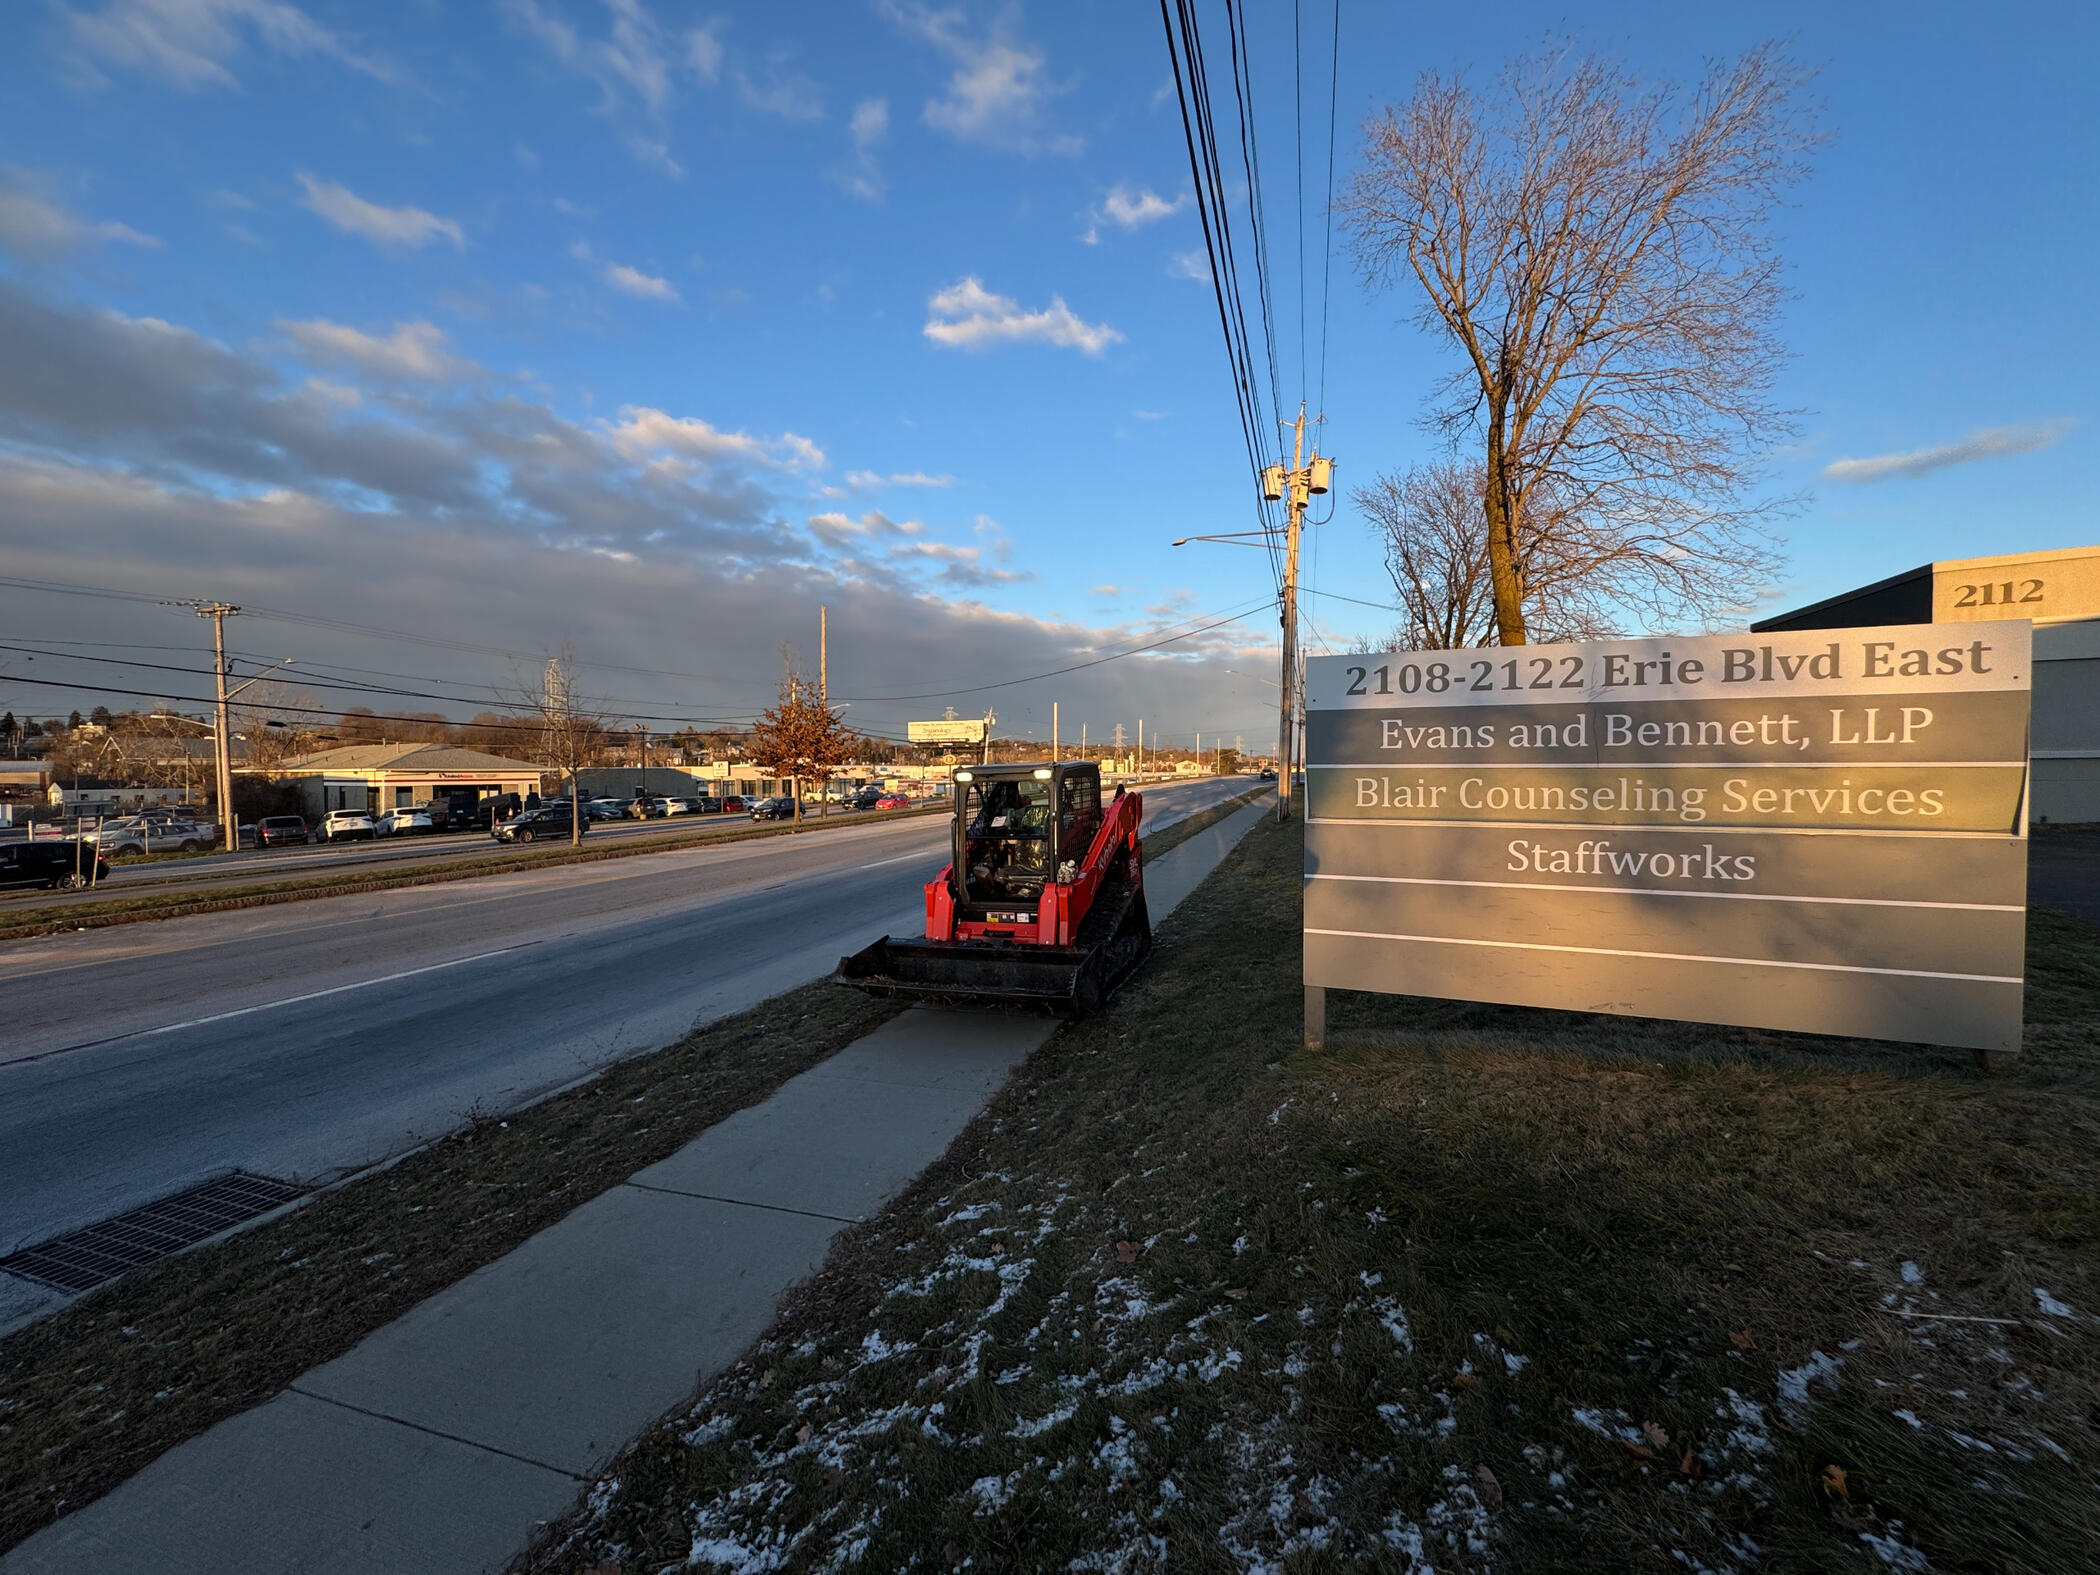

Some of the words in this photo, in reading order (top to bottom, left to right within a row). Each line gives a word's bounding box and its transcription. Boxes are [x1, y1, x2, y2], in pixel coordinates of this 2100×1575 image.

[1954, 579, 2044, 608] 2112
[1346, 656, 1585, 696] 2108-2122
[1601, 652, 1704, 687] Erie
[1721, 643, 1842, 683] Blvd
[1861, 640, 1992, 678] East
[1380, 719, 1495, 749] Evans
[1508, 714, 1588, 748] and
[1604, 714, 1810, 750] Bennett,
[1829, 707, 1934, 744] LLP
[1355, 777, 1447, 808] Blair
[1459, 778, 1708, 822] Counseling
[1722, 779, 1945, 816] Services
[1508, 840, 1756, 880] Staffworks
